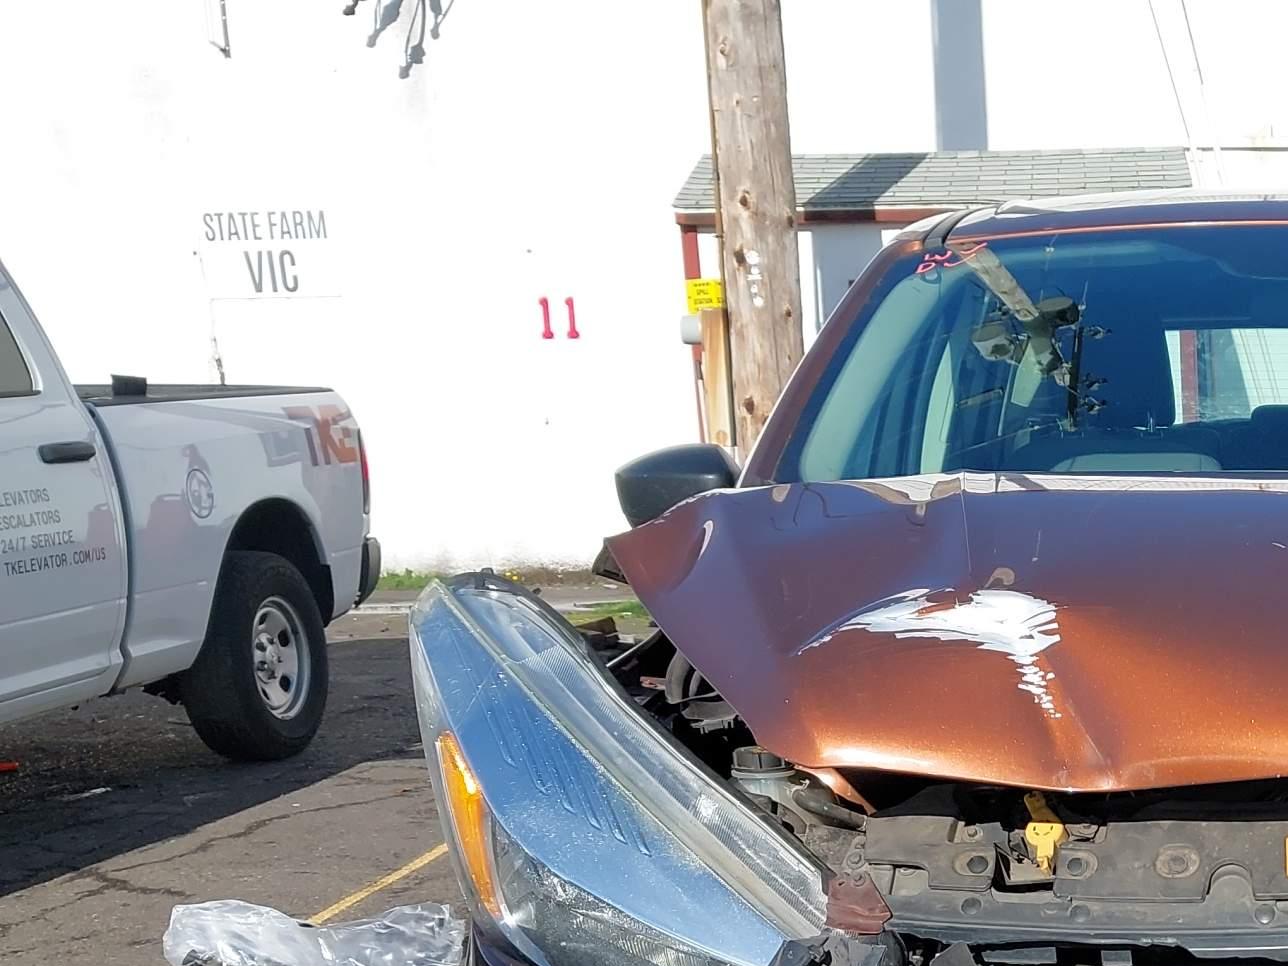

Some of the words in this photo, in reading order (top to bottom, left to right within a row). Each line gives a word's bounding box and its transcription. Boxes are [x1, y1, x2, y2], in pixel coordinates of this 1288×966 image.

[203, 211, 262, 241] STATE
[267, 210, 328, 240] FARM
[243, 250, 299, 293] VIC
[538, 296, 580, 340] 11
[1, 536, 26, 554] 24/7
[31, 529, 76, 549] SERVICE
[4, 547, 106, 577] TKELEVATOR.COM/US
